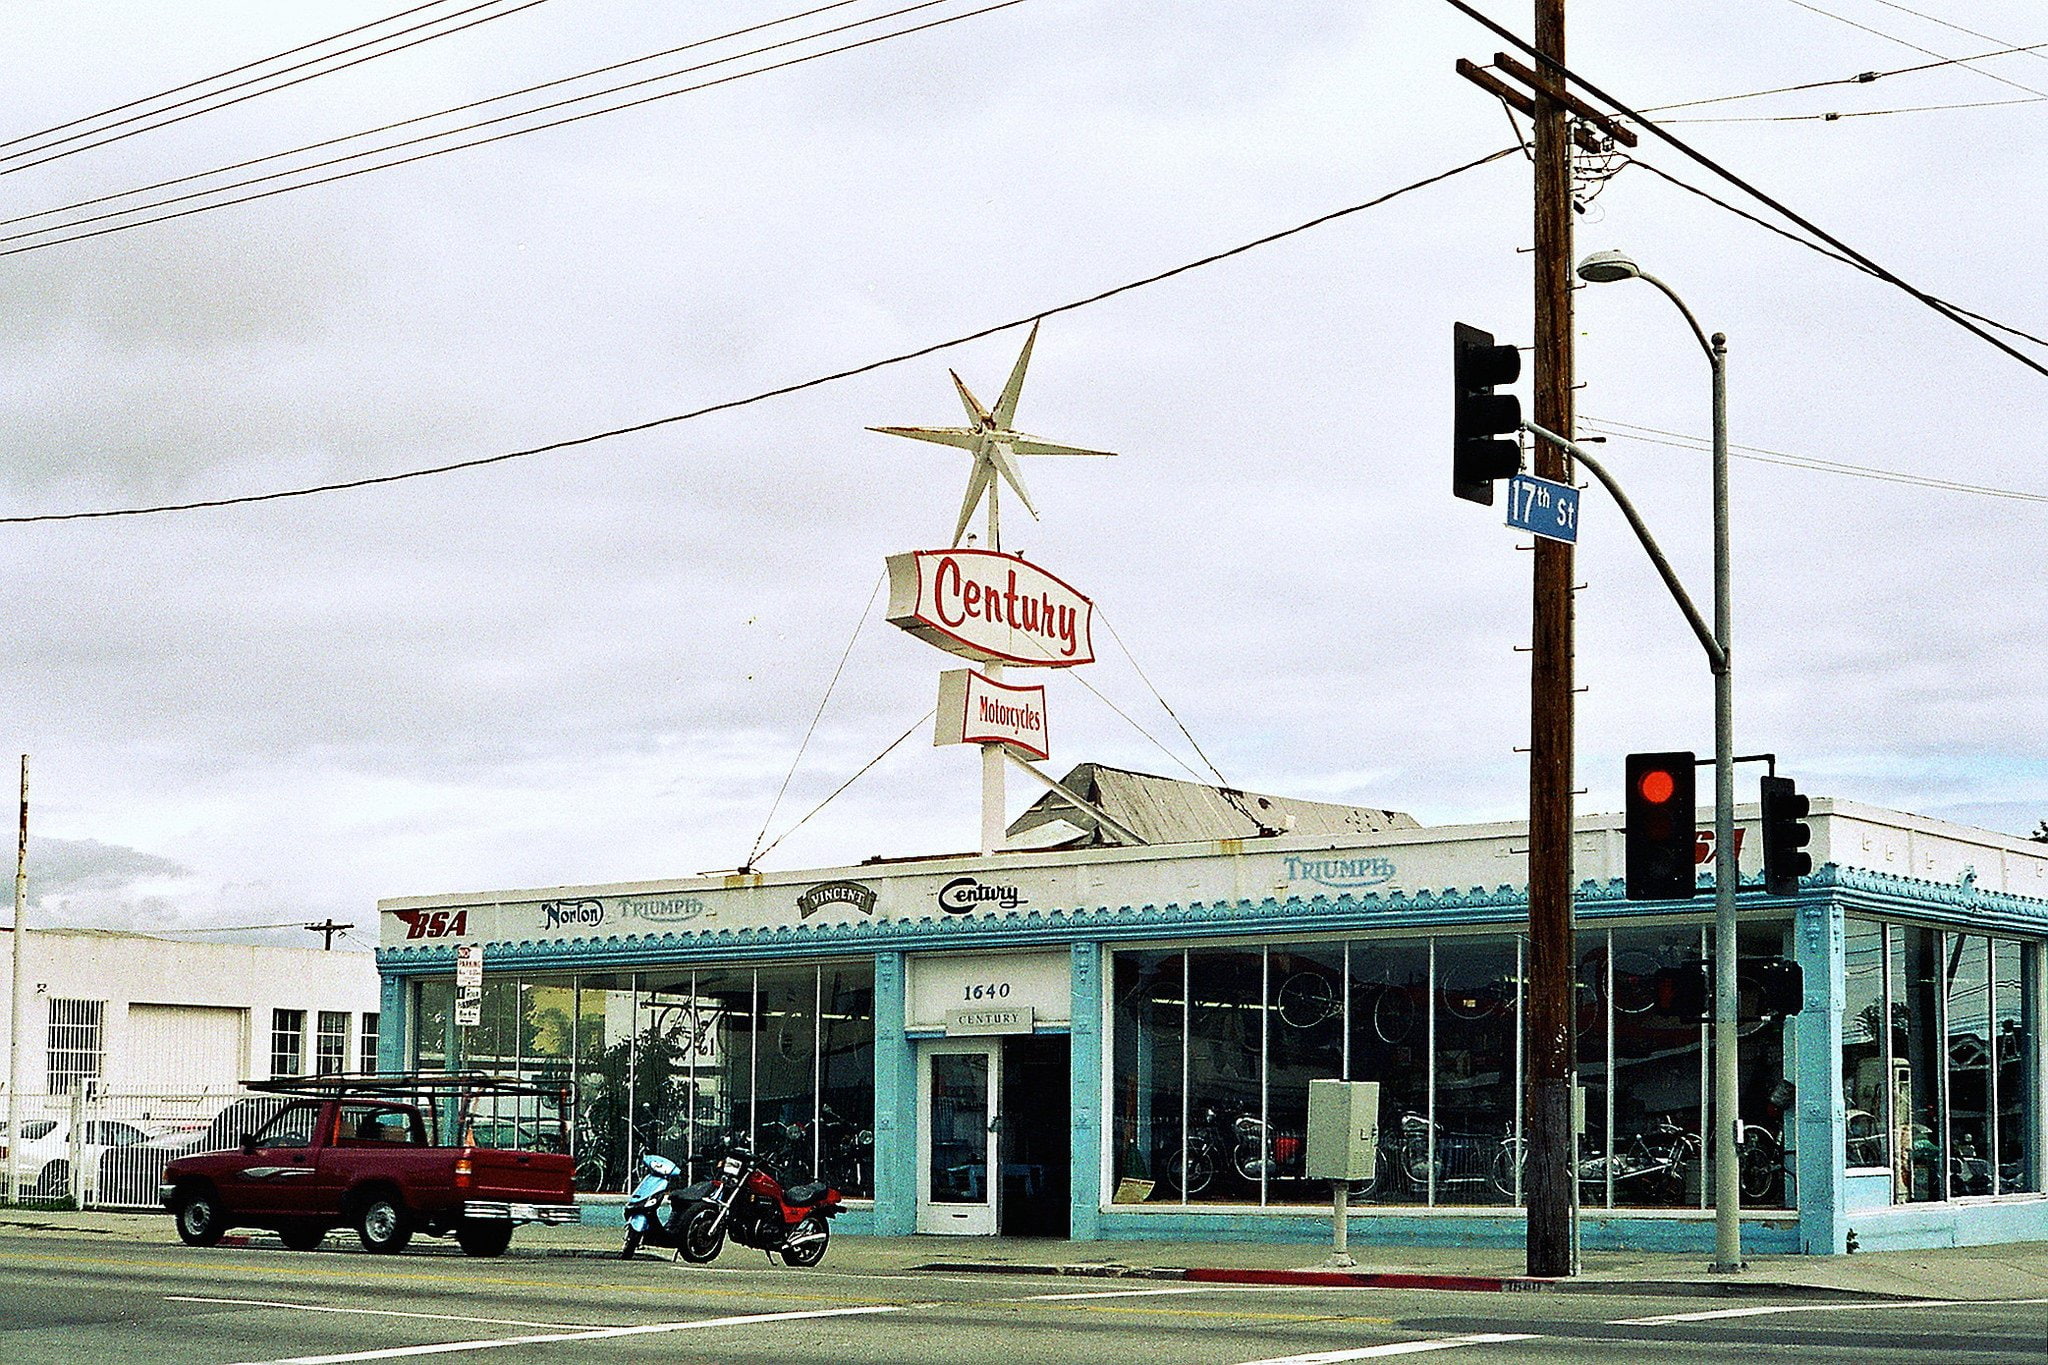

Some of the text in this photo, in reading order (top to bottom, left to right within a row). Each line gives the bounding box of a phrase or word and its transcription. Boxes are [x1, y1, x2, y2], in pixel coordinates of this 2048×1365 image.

[1512, 479, 1575, 530] 17th St
[934, 556, 1077, 657] Century
[979, 695, 1041, 735] Motorcycles
[1282, 856, 1397, 888] TRIUMPH
[617, 898, 704, 922] TRIUMPH
[809, 886, 866, 905] VINCENT
[938, 877, 1029, 915] Century
[403, 909, 468, 940] BSA
[541, 900, 604, 931] Norton
[964, 983, 1010, 1001] 1640
[958, 1013, 1018, 1025] CENTURY
